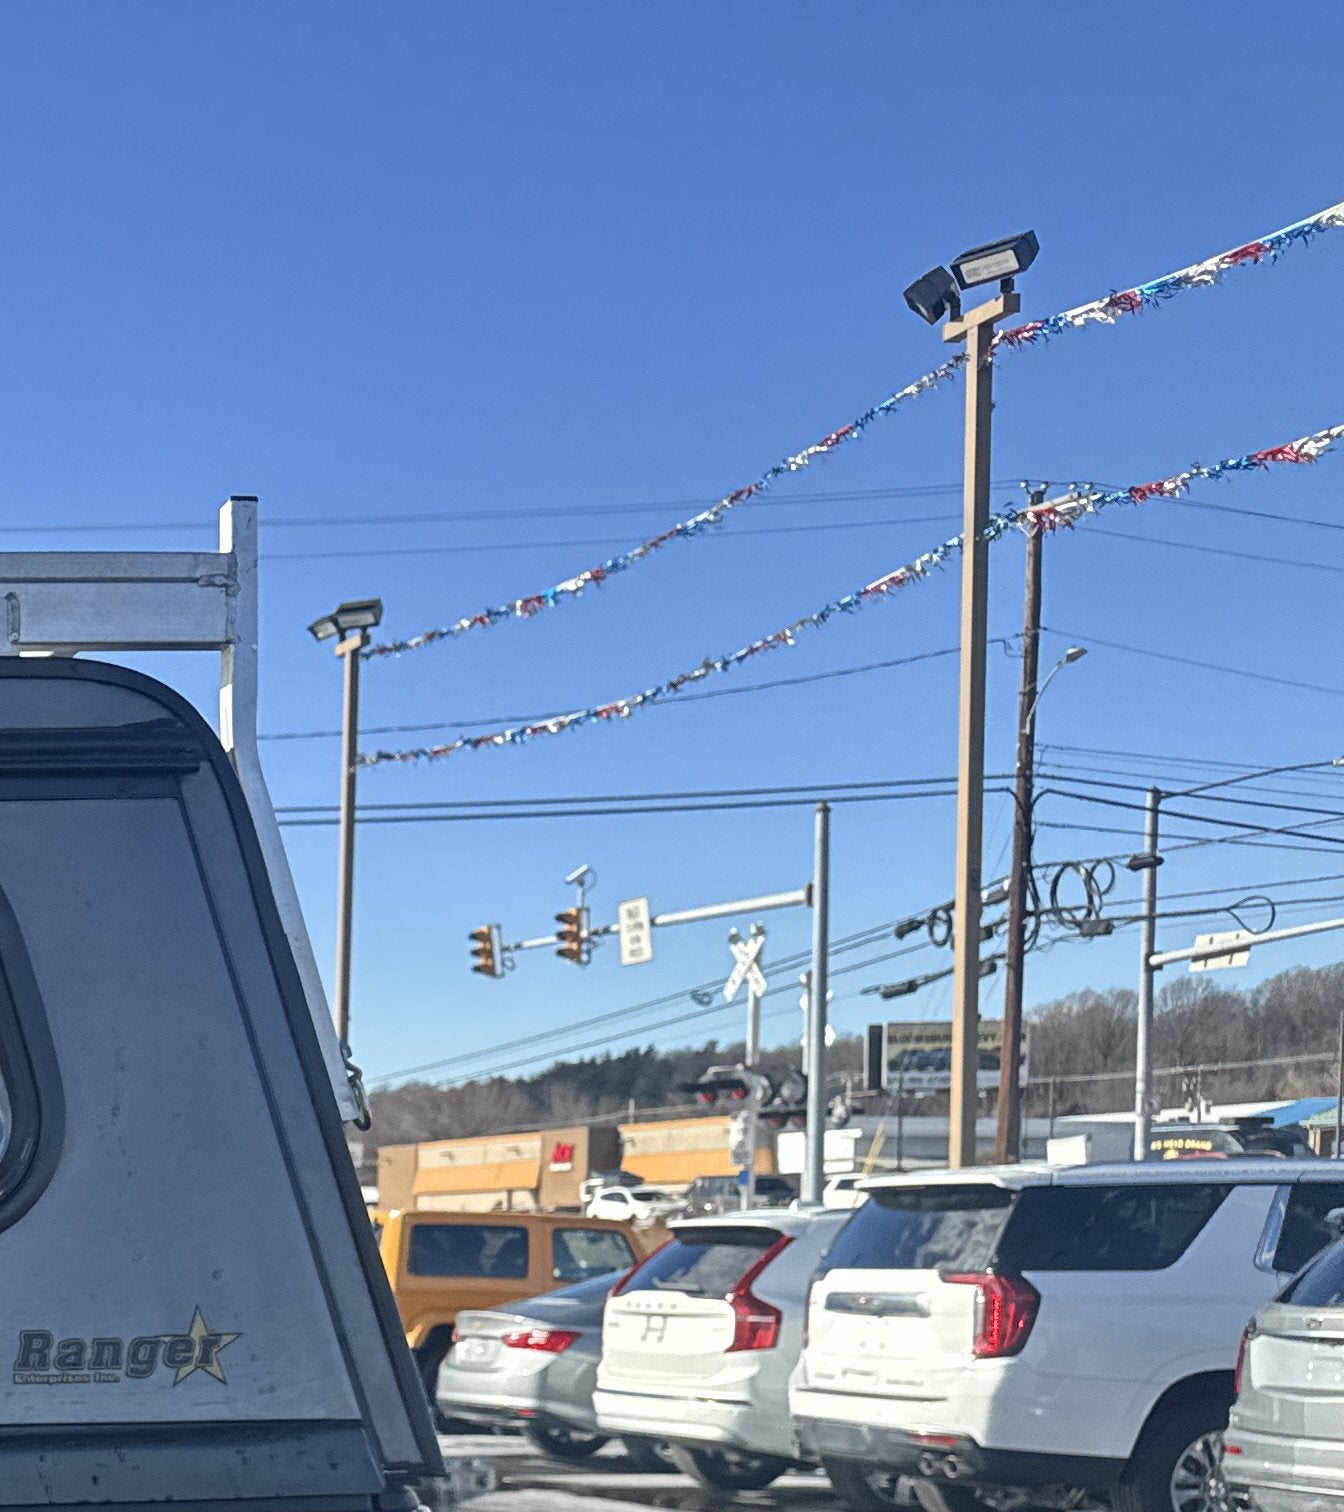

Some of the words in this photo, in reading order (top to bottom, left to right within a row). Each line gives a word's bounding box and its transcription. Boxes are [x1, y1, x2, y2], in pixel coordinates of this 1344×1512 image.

[13, 1329, 222, 1379] Ranger
[14, 1373, 90, 1385] Enterprises
[93, 1372, 121, 1383] Inc.
